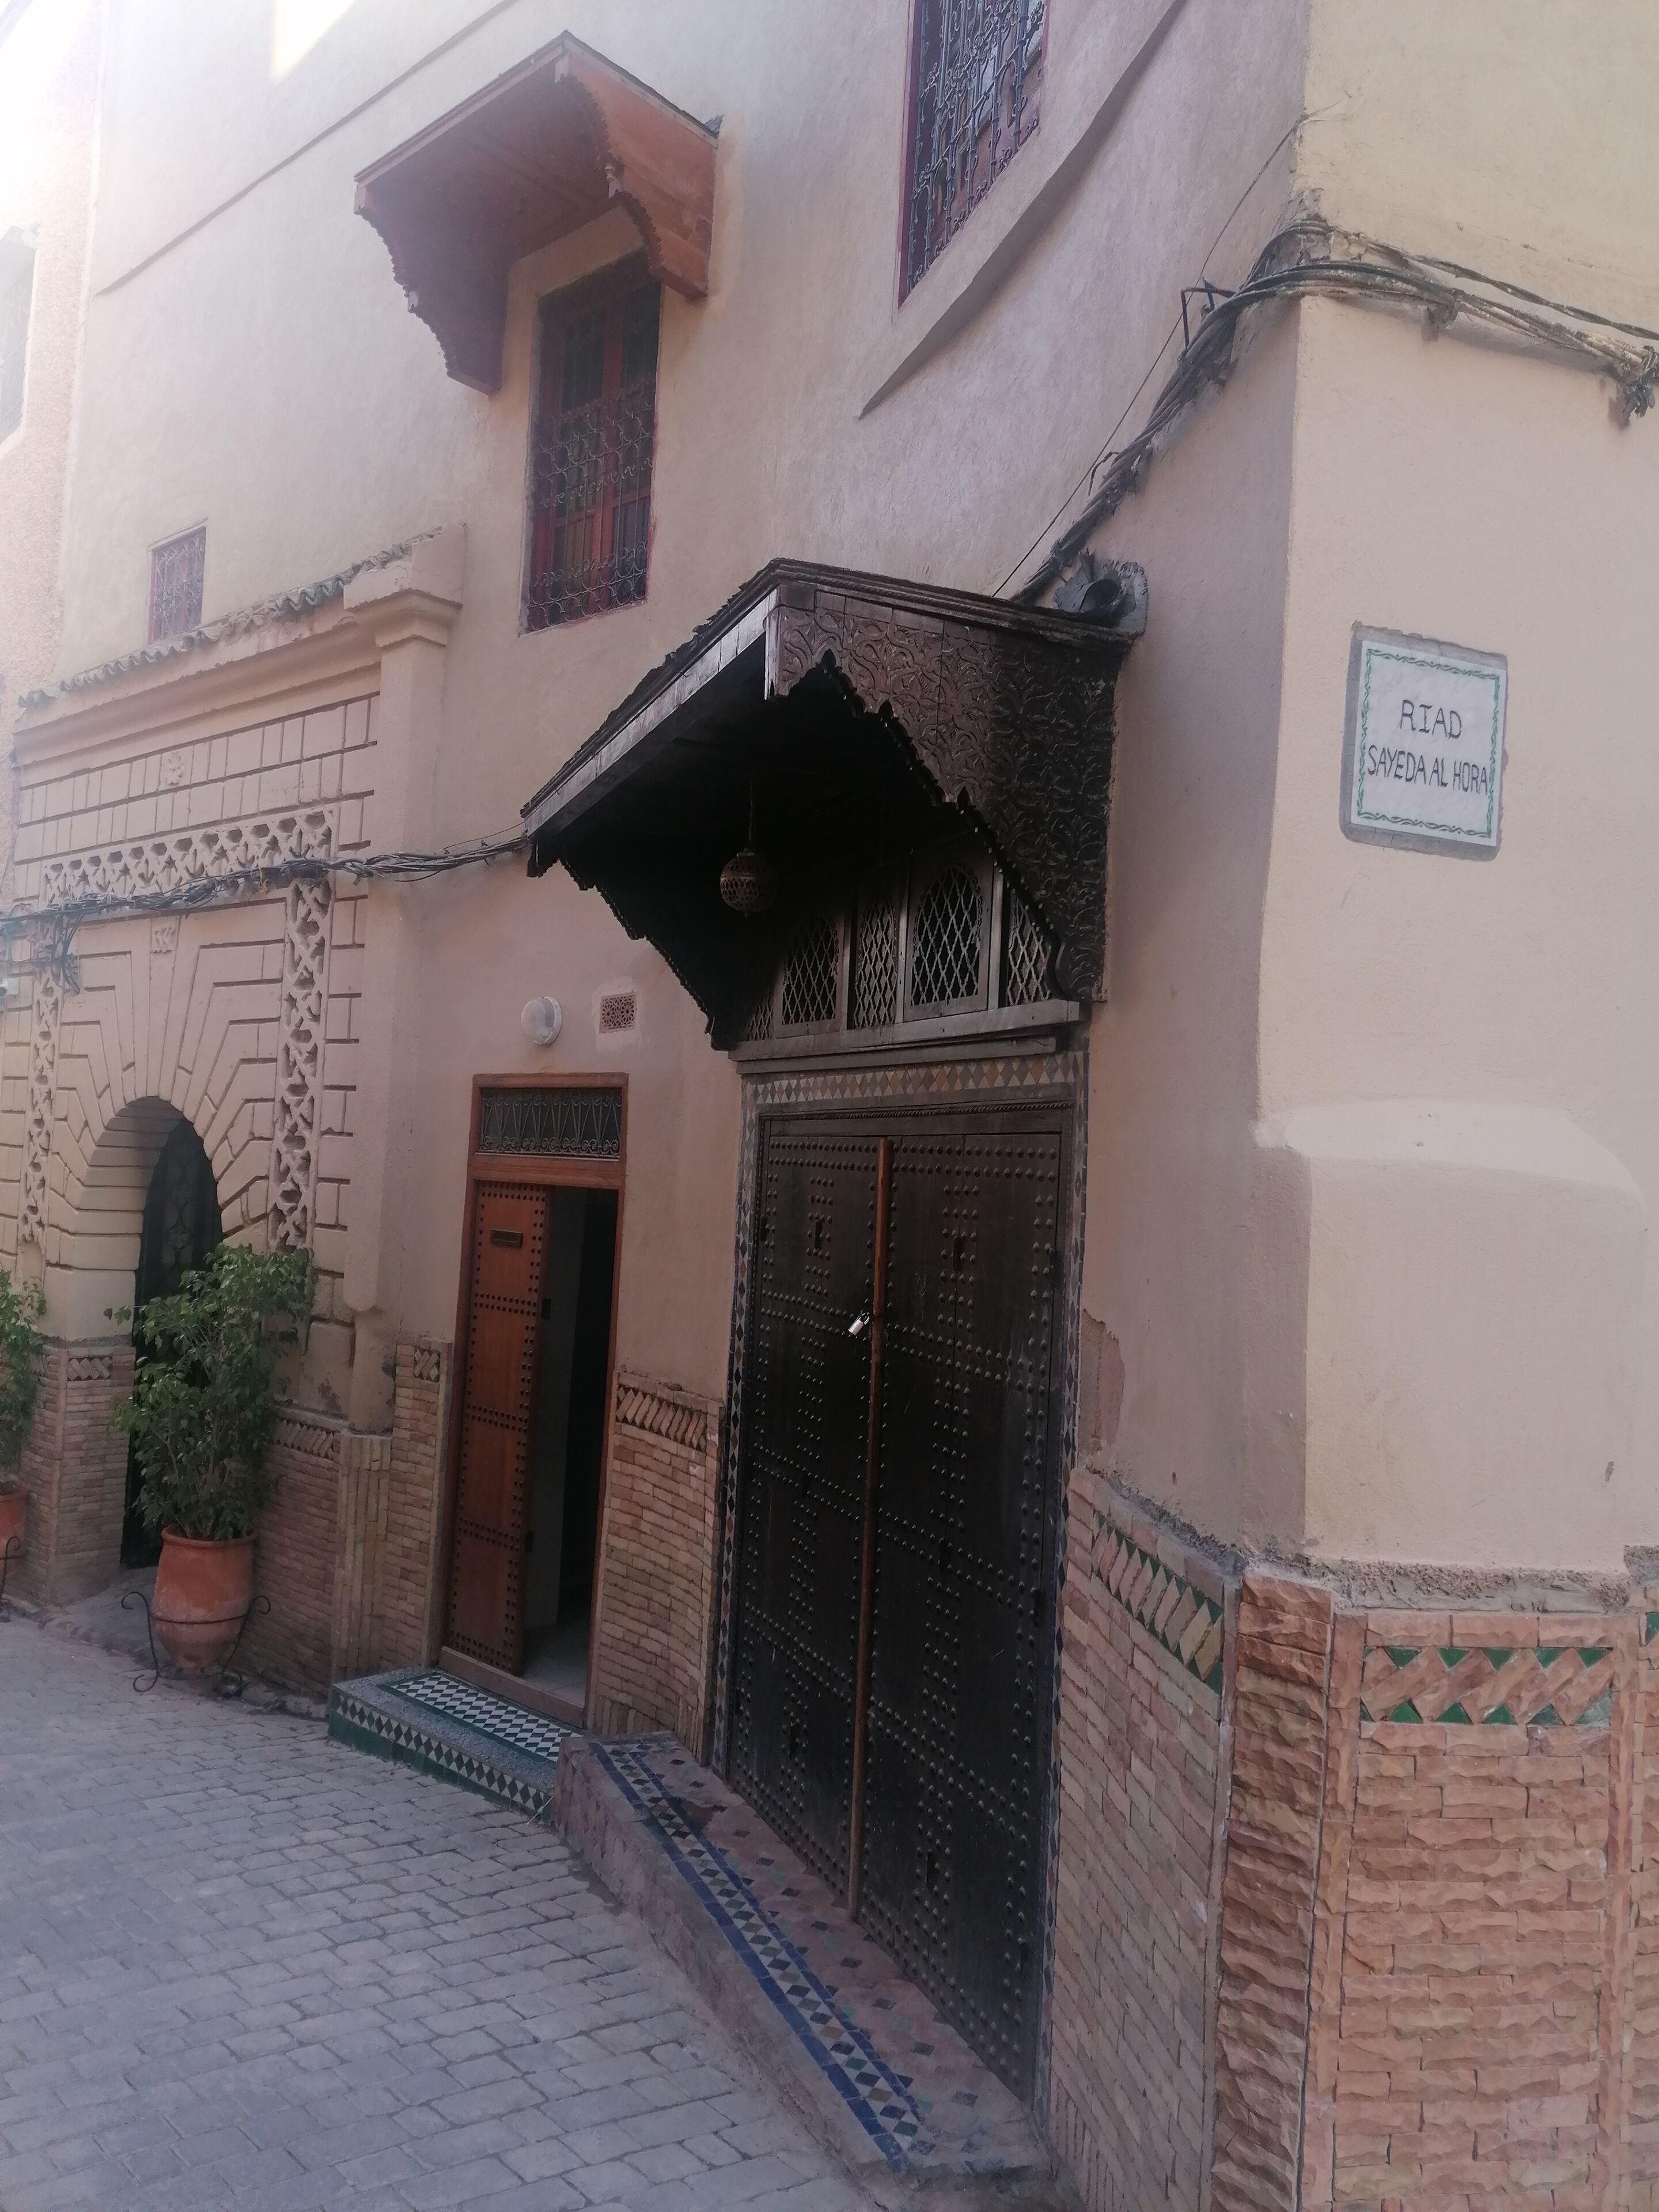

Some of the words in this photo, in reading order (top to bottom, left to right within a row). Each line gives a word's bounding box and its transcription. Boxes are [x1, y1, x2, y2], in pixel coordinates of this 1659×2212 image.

[1400, 699, 1462, 738] RIAD
[1368, 745, 1426, 784] SAYEDA
[1429, 757, 1448, 788] AL
[1452, 760, 1488, 796] HORA
